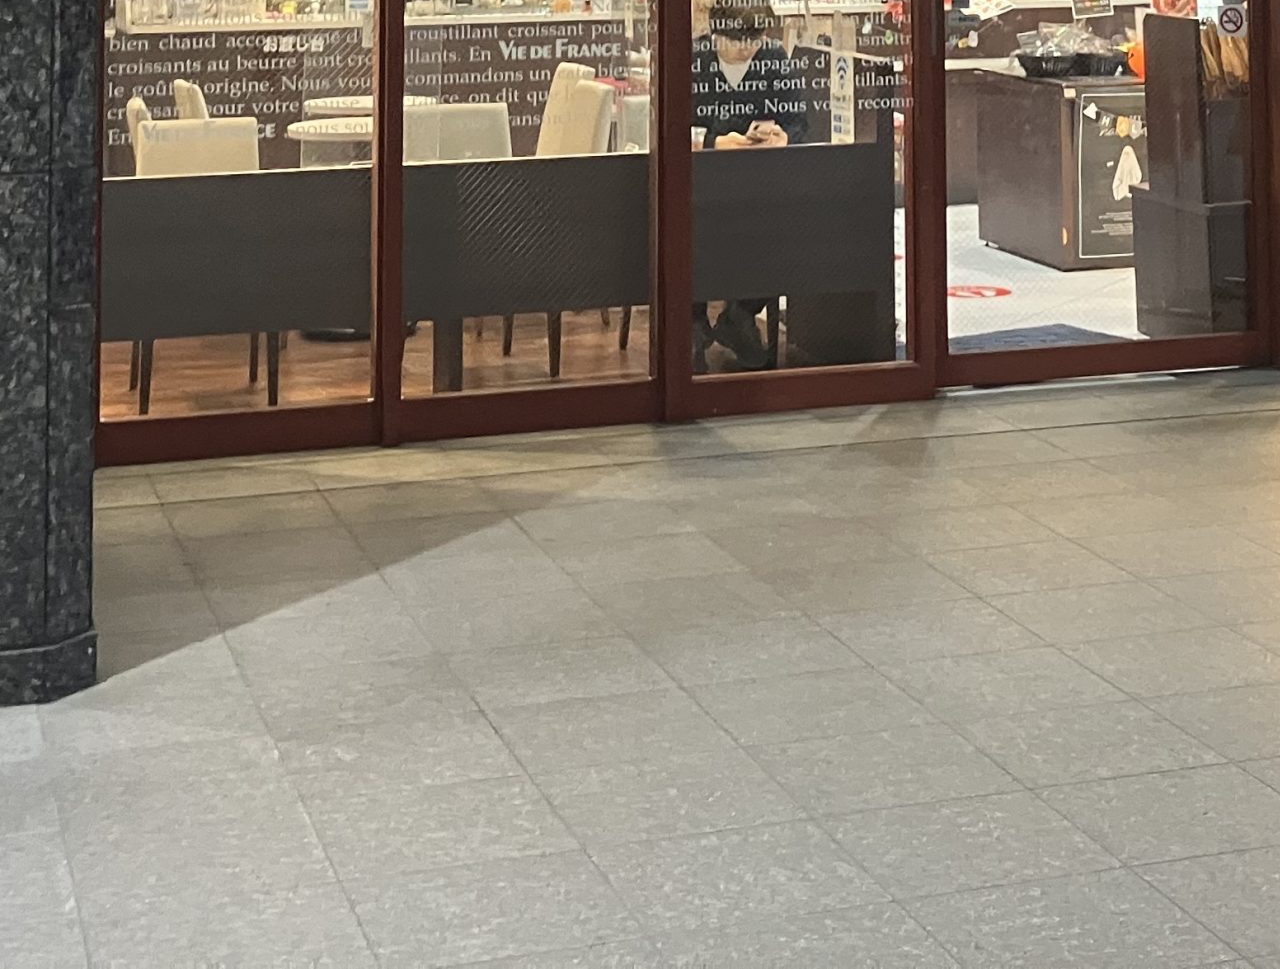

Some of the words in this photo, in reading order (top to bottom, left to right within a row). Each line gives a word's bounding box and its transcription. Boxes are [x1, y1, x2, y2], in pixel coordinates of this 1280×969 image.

[508, 22, 582, 38] croissant
[109, 34, 149, 52] bien
[159, 33, 216, 50] chaud
[469, 46, 491, 62] En
[499, 39, 527, 60] VIE
[530, 44, 552, 59] DE
[555, 38, 621, 58] FRANCE
[107, 57, 201, 75] croissants
[207, 59, 230, 72] au
[237, 54, 297, 72] beurre
[405, 67, 523, 85] commandons
[529, 69, 551, 82] un
[108, 82, 125, 99] le
[773, 77, 806, 92] sont
[496, 88, 520, 103] dit
[252, 99, 299, 114] votre
[764, 98, 807, 114] Nous
